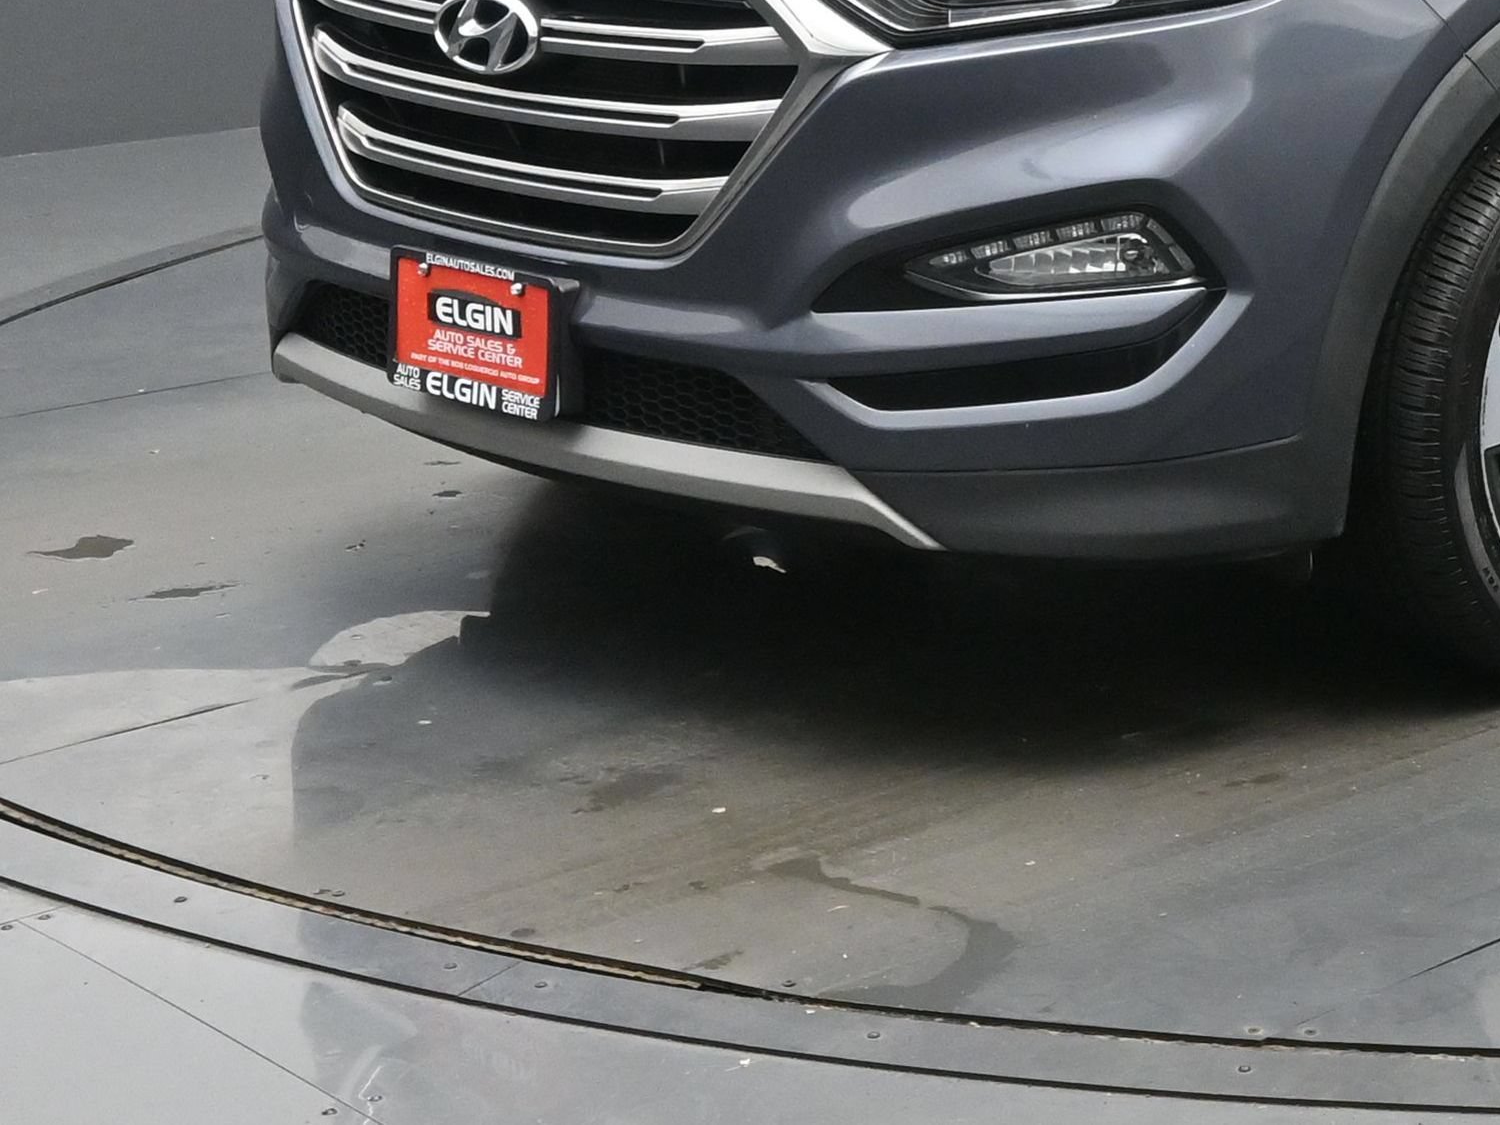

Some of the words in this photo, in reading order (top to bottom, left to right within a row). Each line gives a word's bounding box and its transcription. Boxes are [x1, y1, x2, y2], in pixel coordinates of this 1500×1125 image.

[426, 252, 515, 281] ELGINAUTOSALES.COM
[436, 297, 513, 336] ELGIN
[427, 339, 475, 358] SERVICE
[477, 350, 523, 368] CENTER
[433, 329, 464, 344] AUTO
[466, 335, 503, 353] SALES
[506, 343, 516, 355] &
[393, 374, 421, 391] SALES
[396, 362, 420, 379] AUTO
[426, 371, 496, 410] ELGIN
[501, 388, 540, 408] SERVICE
[502, 401, 538, 420] CENTER
